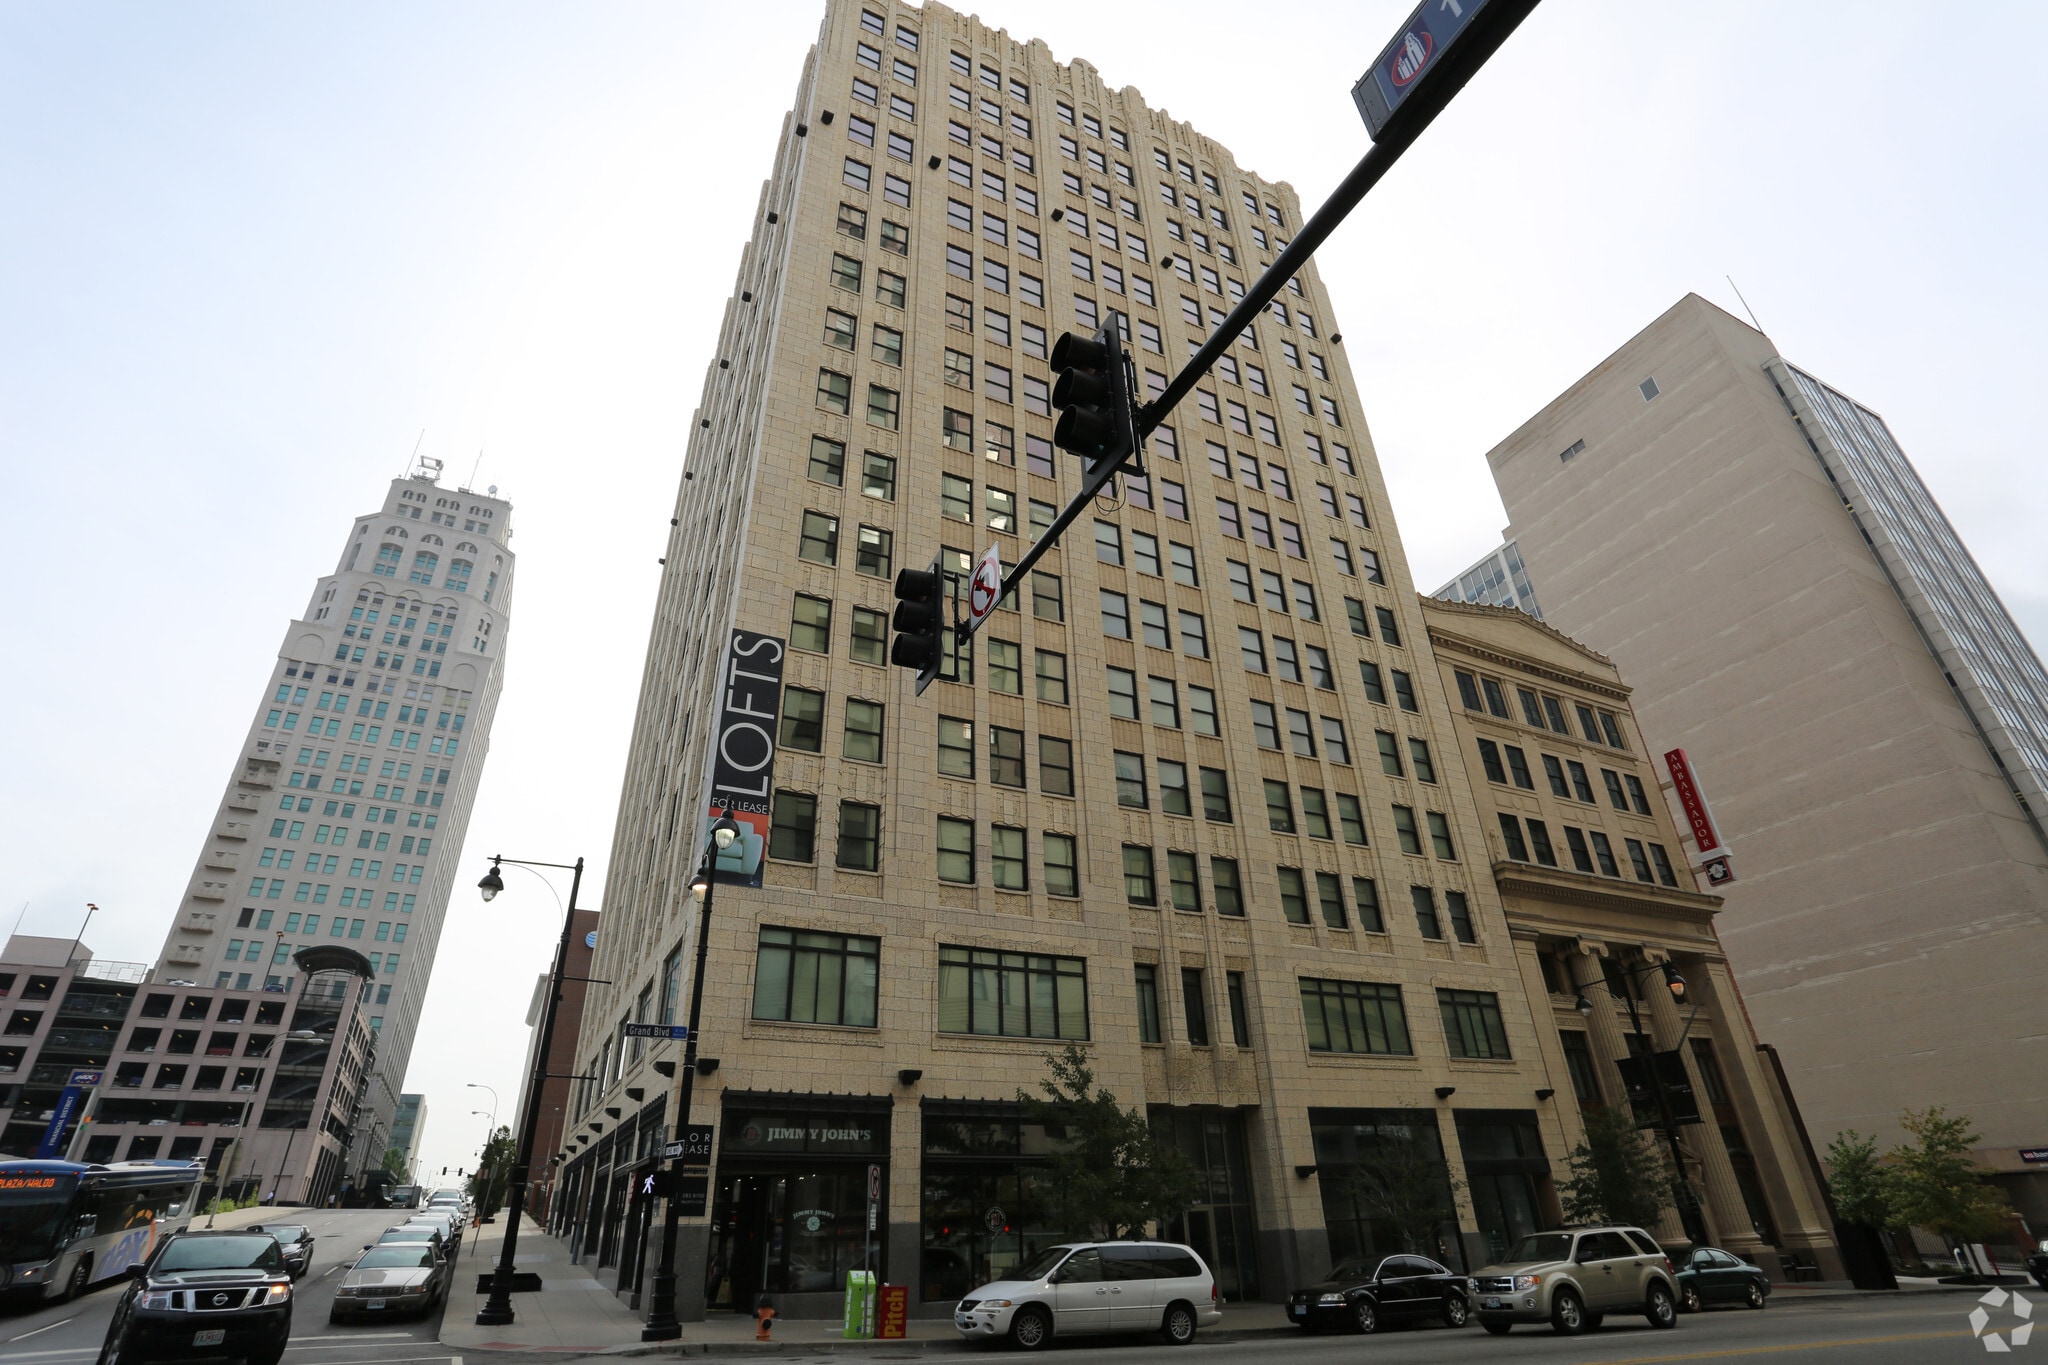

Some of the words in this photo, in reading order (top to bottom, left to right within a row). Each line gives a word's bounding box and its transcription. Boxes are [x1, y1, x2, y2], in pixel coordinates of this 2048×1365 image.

[716, 634, 783, 797] LOFTS
[738, 801, 768, 814] LEASE
[1670, 754, 1712, 847] AMBASSADOR
[629, 1026, 651, 1036] Grand
[654, 1027, 670, 1037] Blvd
[48, 1119, 65, 1146] FINANCIAL
[60, 1096, 75, 1118] DISTRICT
[821, 1128, 871, 1142] JOHN'S
[884, 1290, 904, 1337] Pitch
